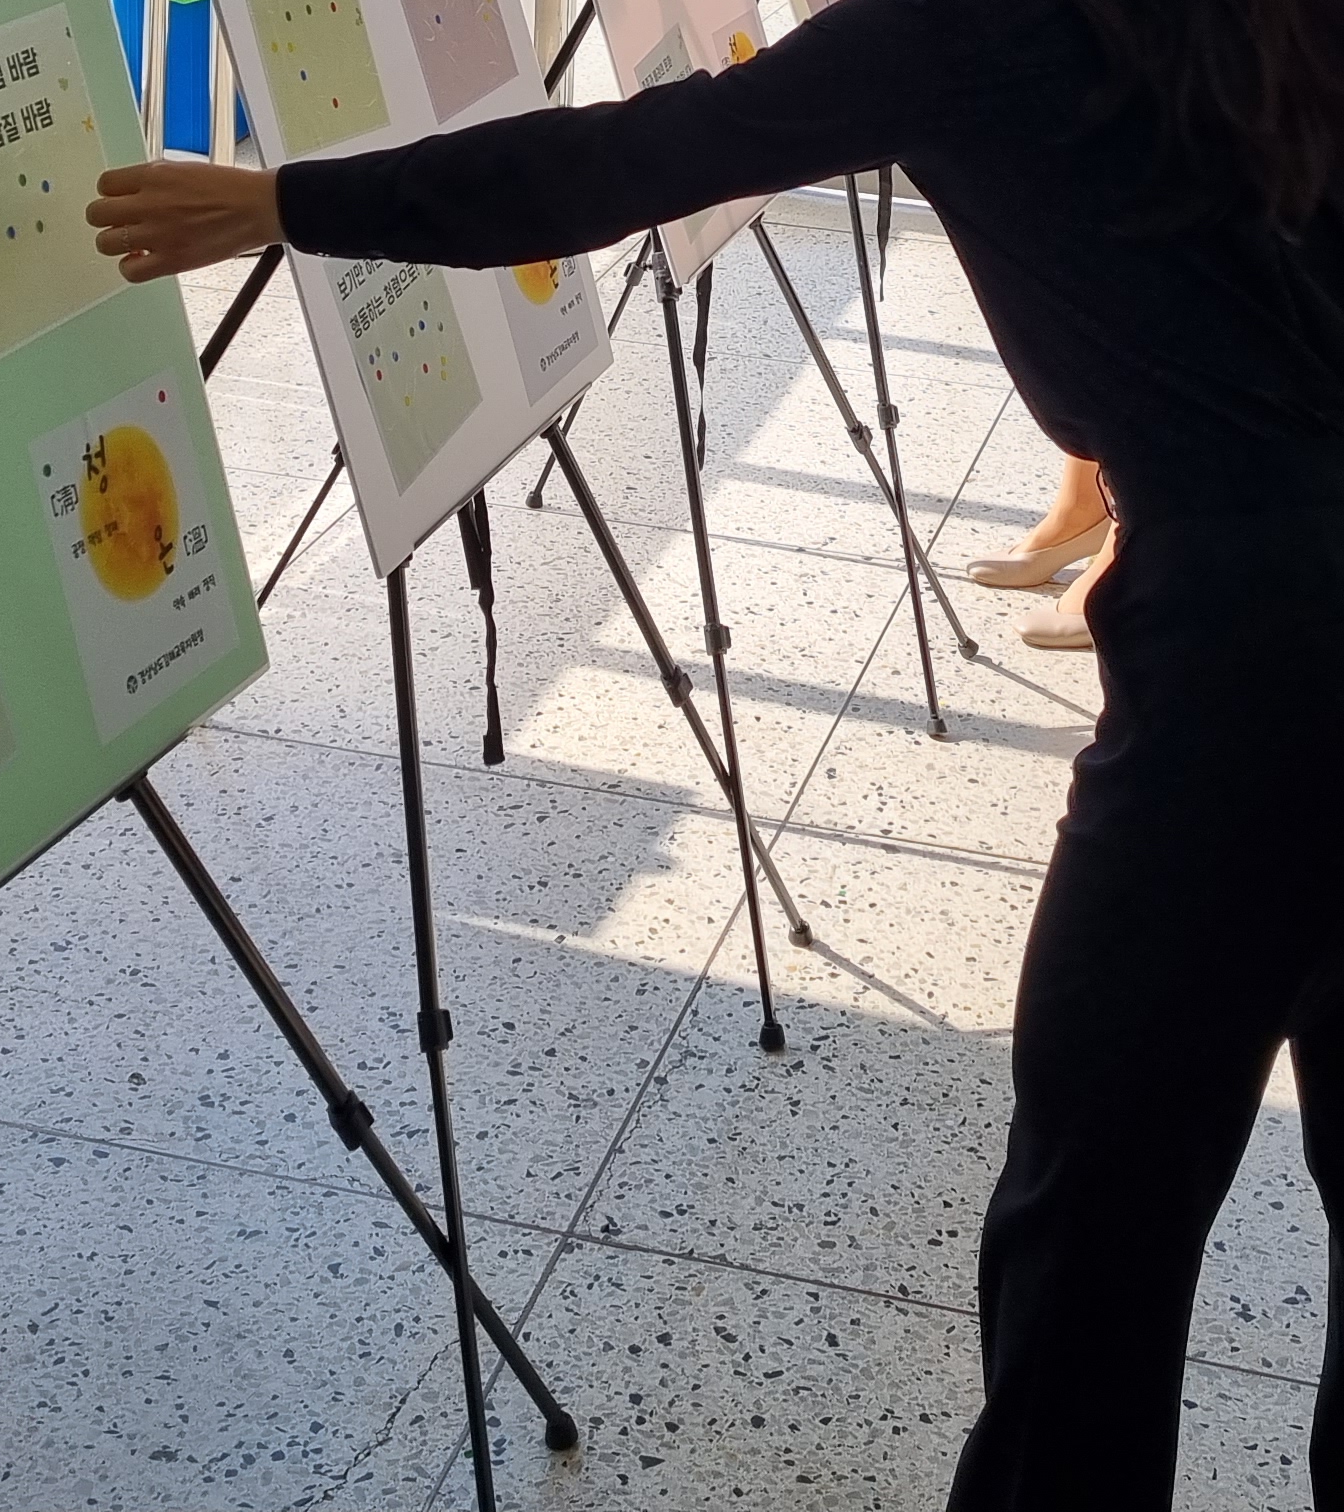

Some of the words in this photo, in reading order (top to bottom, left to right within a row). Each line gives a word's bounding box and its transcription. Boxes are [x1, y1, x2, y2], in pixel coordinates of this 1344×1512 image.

[7, 46, 40, 81] 바람
[21, 99, 55, 132] 바람
[337, 266, 365, 301] 보기만
[349, 293, 386, 339] 행동하는
[83, 434, 108, 494] 청
[154, 524, 175, 576] 온
[138, 628, 205, 687] 경상남도김해교육지원청
